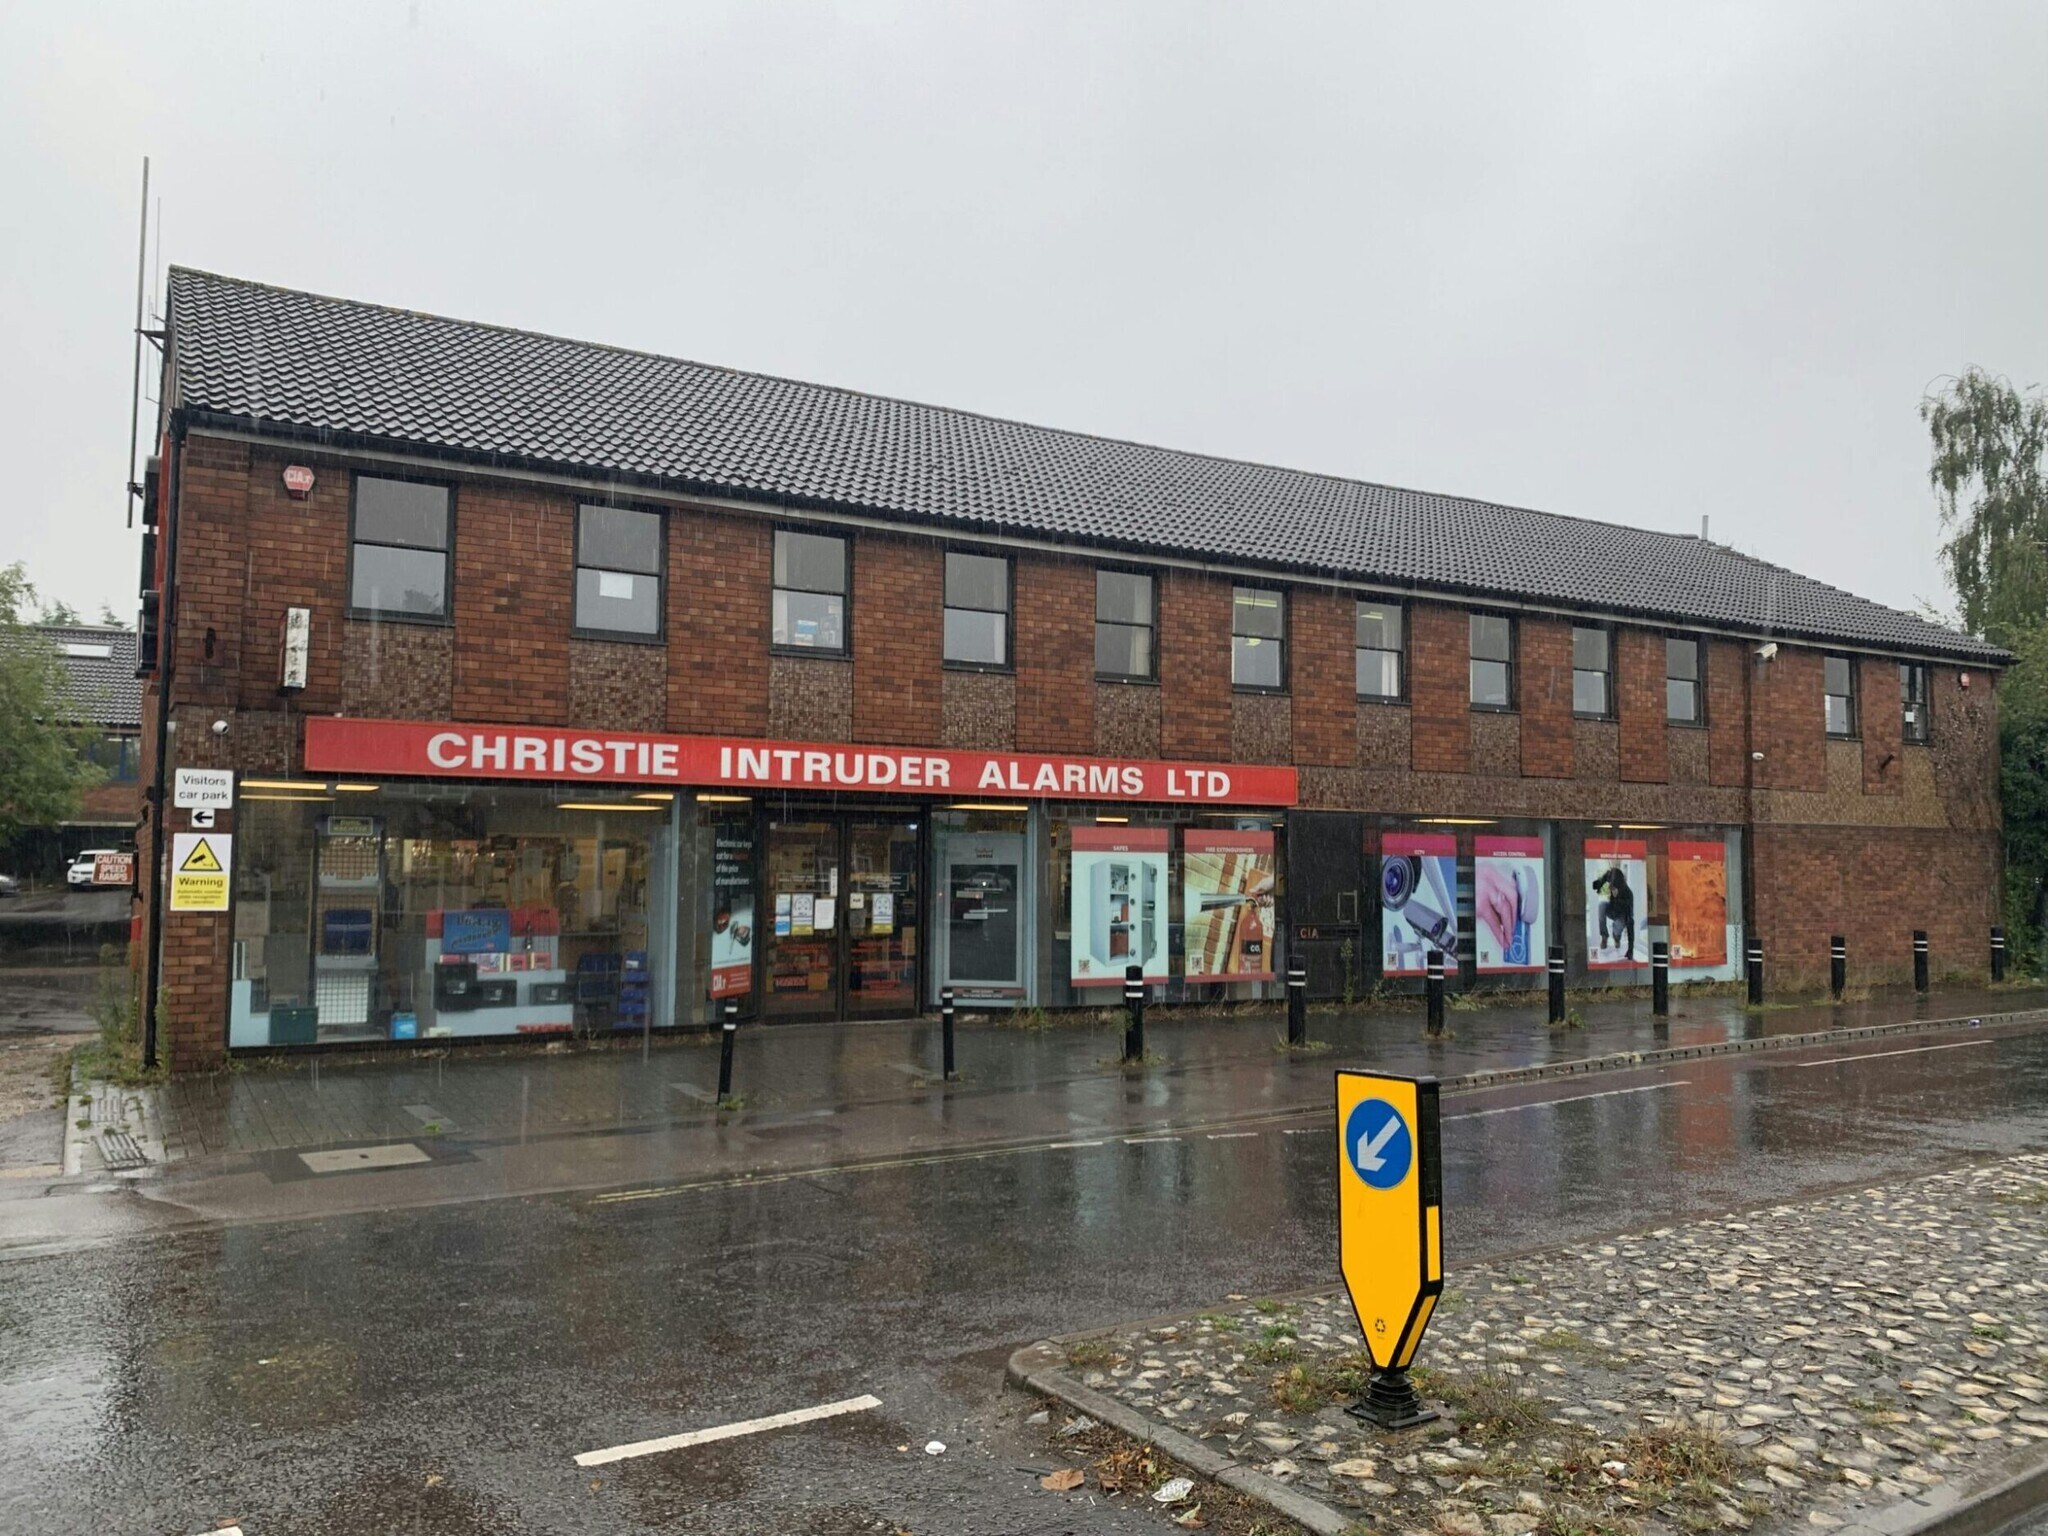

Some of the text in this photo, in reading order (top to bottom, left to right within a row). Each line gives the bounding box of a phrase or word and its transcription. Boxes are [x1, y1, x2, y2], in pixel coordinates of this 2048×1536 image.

[427, 732, 1231, 798] CHRISTIE INTRUDER ALARMS LTD
[182, 775, 227, 786] Visitors
[179, 790, 229, 801] car park
[97, 855, 133, 865] CAUTION
[100, 864, 127, 873] SPEED
[98, 872, 129, 881] RAMPS
[179, 877, 224, 888] Warning
[1299, 927, 1320, 940] CIA
